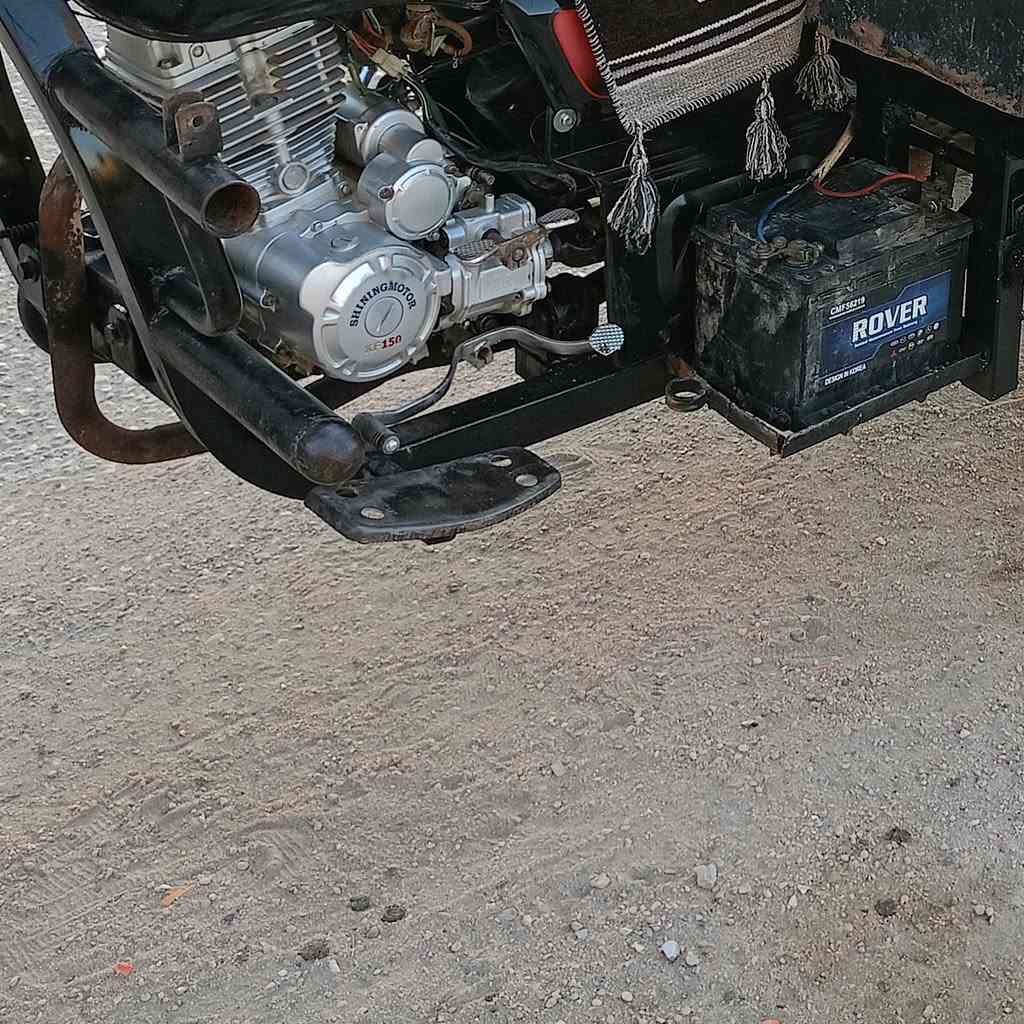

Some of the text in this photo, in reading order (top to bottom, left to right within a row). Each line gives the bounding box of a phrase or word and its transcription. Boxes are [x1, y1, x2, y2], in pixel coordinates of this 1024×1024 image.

[349, 281, 416, 327] SHININGMOTOR
[852, 295, 927, 343] ROVER
[824, 373, 843, 386] DESIGN
[849, 363, 866, 375] KOREA
